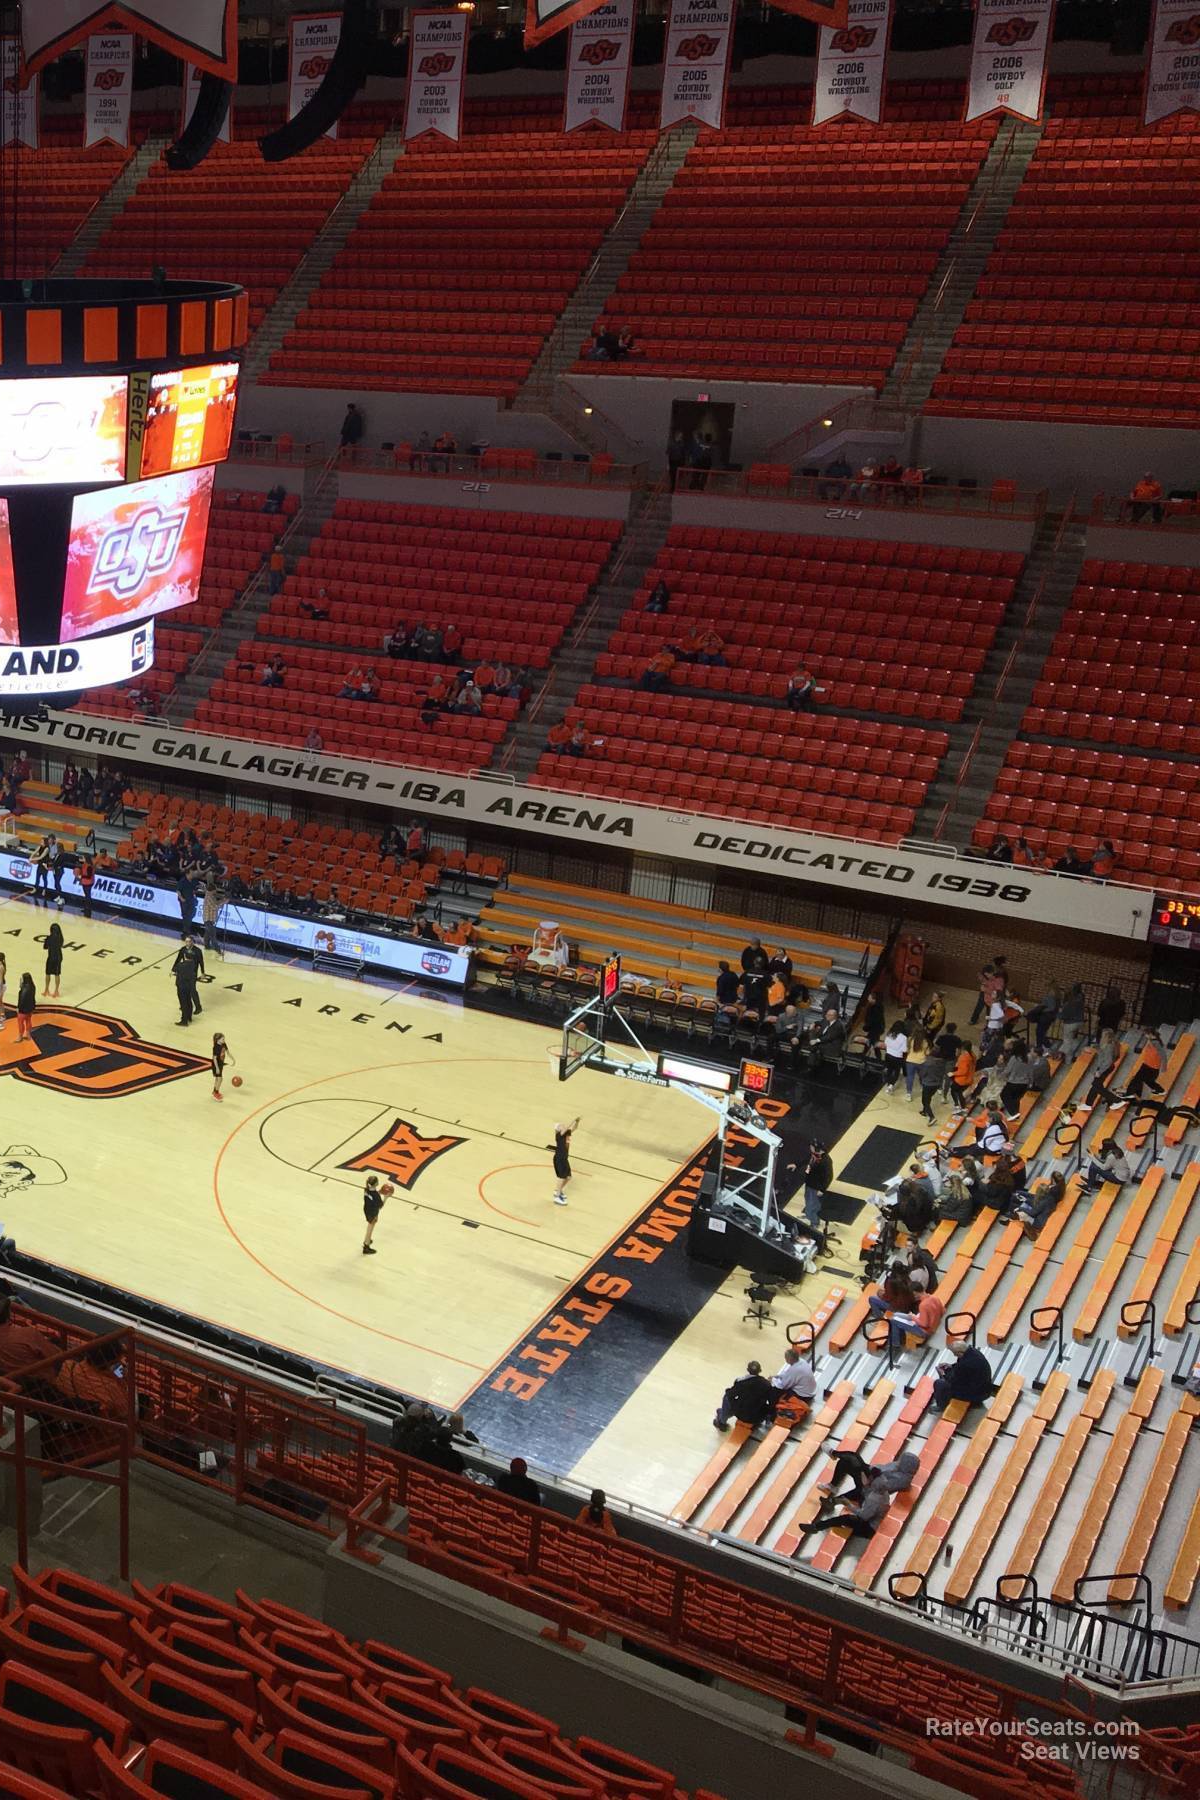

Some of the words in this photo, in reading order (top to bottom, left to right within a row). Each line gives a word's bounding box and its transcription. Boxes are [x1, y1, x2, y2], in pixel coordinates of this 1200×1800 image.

[689, 0, 717, 9] NCAA
[848, 3, 886, 14] MPIONS
[576, 18, 628, 28] CHAMPIONS
[674, 13, 729, 23] CHAMPIONS
[306, 25, 328, 34] NCAA
[428, 20, 451, 30] NCAA
[295, 36, 338, 47] CHAMPIONS
[415, 32, 462, 42] CHAMPIONS
[101, 40, 121, 48] NCAA
[90, 51, 130, 59] CHAMPIONS
[992, 57, 1023, 69] 2006
[1174, 56, 1200, 69] 200
[837, 63, 864, 74] 2006
[585, 75, 610, 85] 2004
[832, 77, 867, 86] COWBOY
[986, 72, 1026, 82] COWBOY
[424, 86, 446, 95] 2003
[677, 84, 710, 92] COWBOY
[828, 87, 870, 95] WRESTLING
[994, 82, 1015, 90] GOLF
[1152, 84, 1180, 92] CROSS
[100, 99, 117, 107] 1994
[419, 98, 448, 106] COWBOY
[130, 378, 147, 442] Hertz
[462, 481, 490, 492] 213
[825, 508, 864, 520] 214
[85, 502, 191, 600] OSU
[485, 796, 634, 837] ARENA
[693, 831, 915, 884] DEDICATED
[926, 872, 1032, 903] 1938
[73, 877, 154, 902] HMELAND
[1161, 912, 1171, 924] 0
[282, 997, 443, 1043] ARENA
[489, 1272, 633, 1401] STATE
